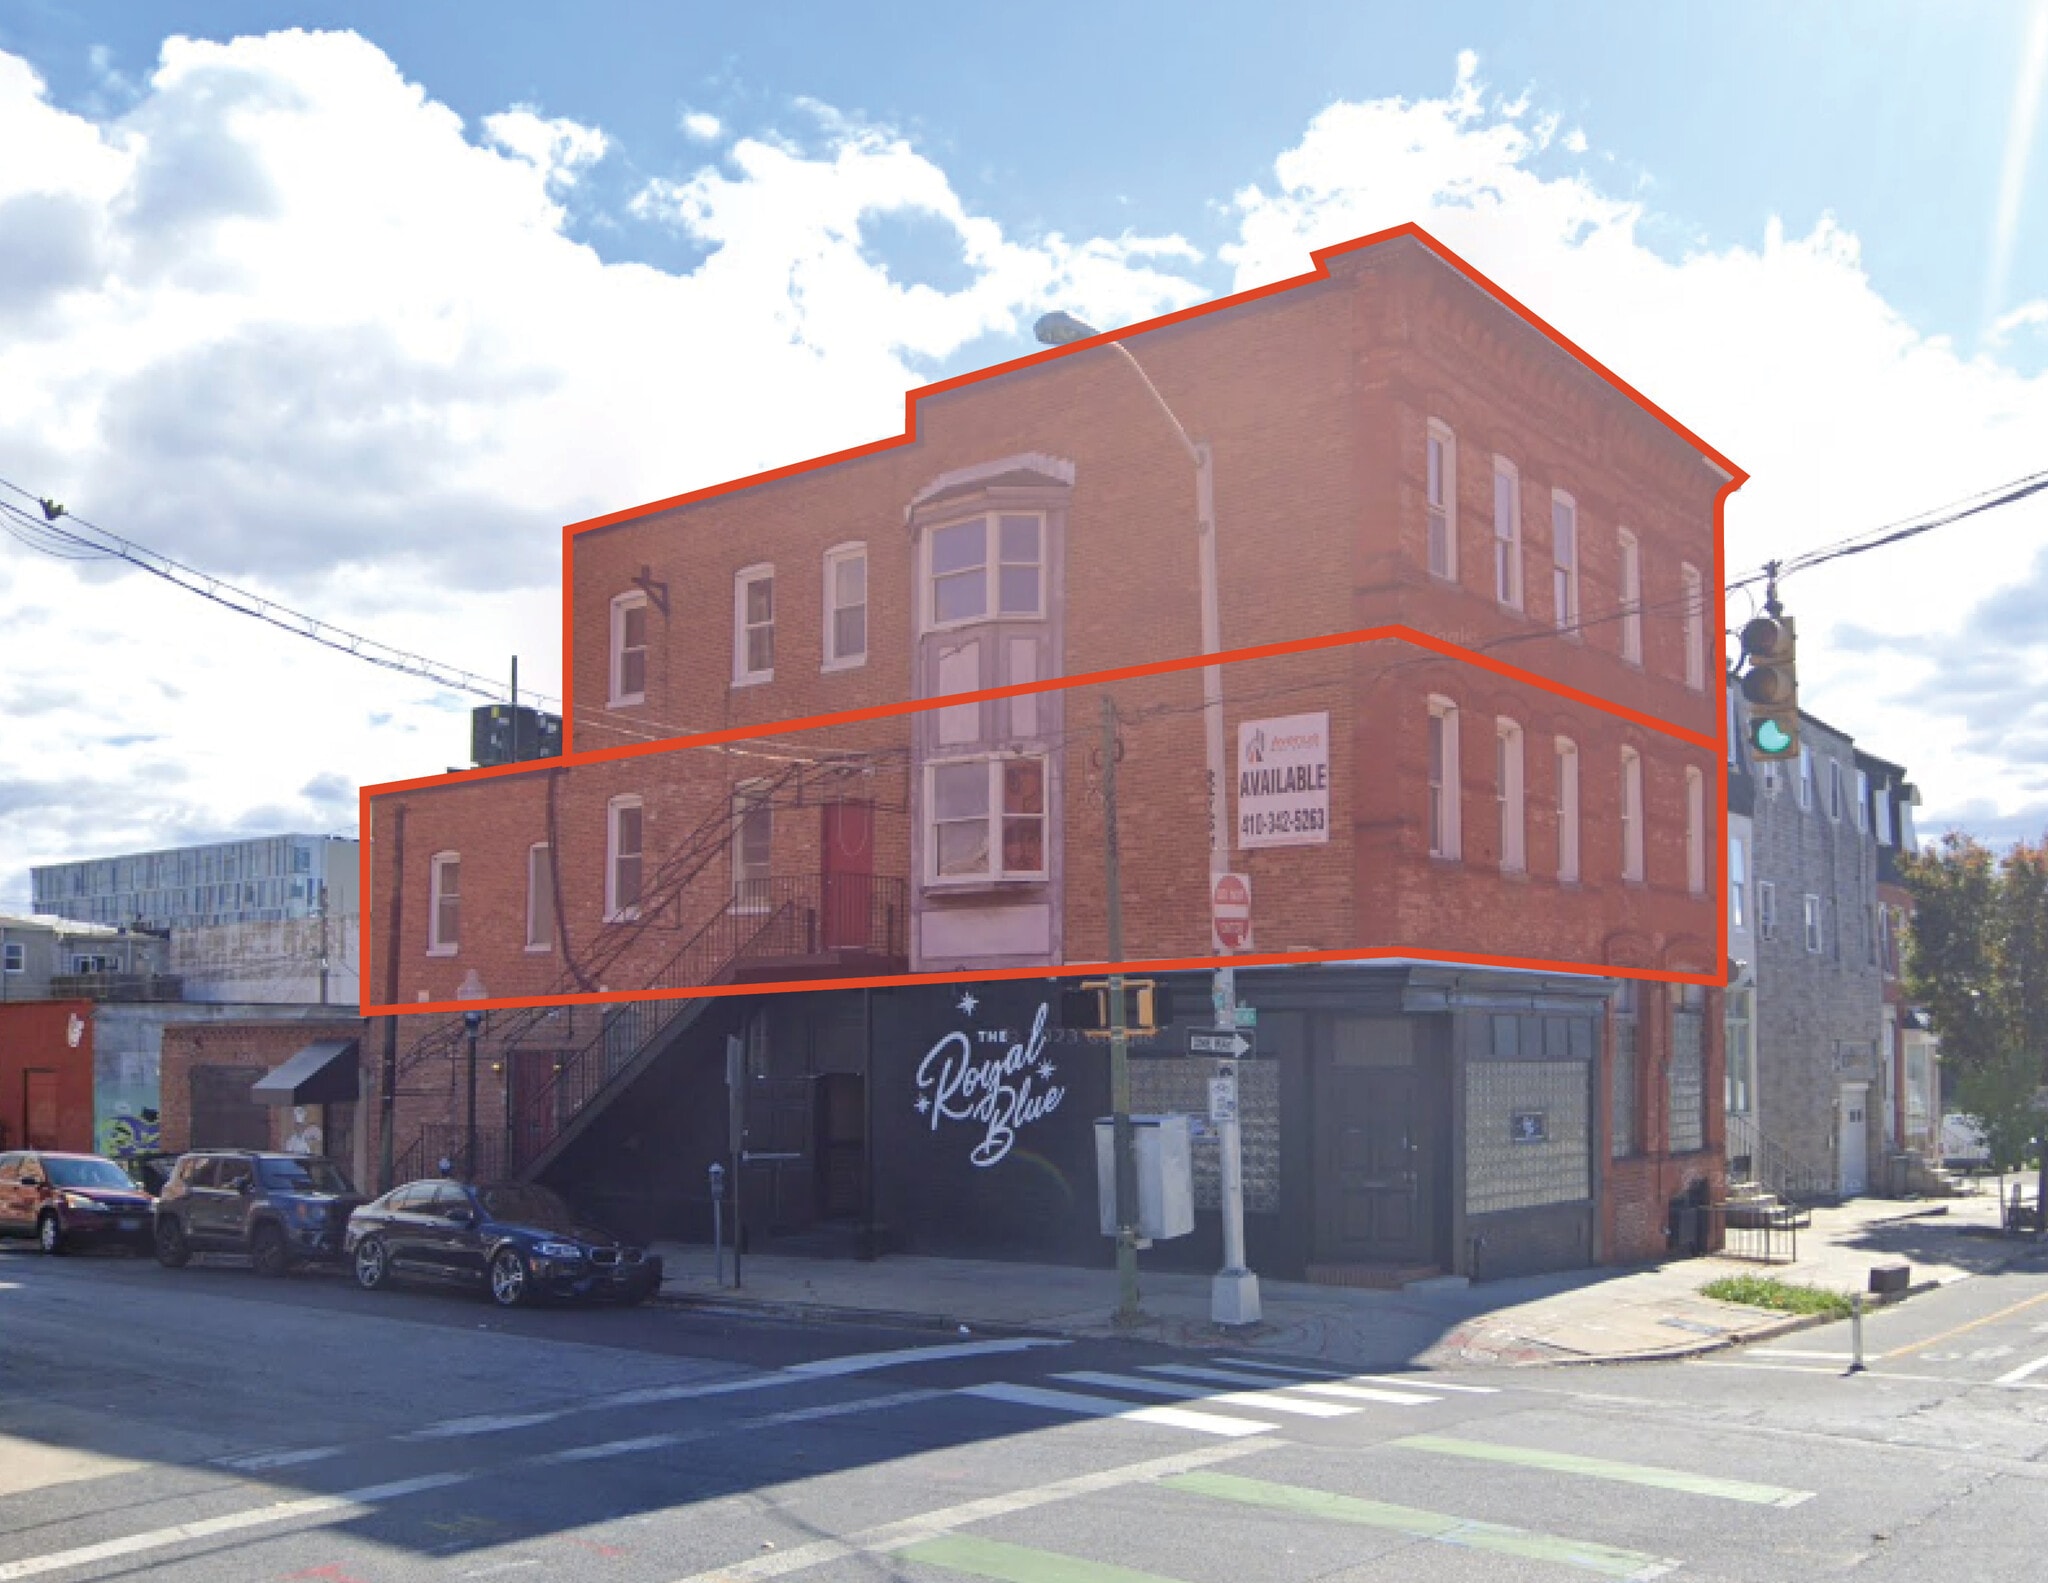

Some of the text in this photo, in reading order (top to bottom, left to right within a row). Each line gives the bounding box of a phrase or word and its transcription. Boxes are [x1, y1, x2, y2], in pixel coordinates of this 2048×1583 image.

[1240, 764, 1327, 797] AVAILABLE
[916, 1001, 1050, 1131] Royal
[978, 1031, 1008, 1043] THE
[970, 1075, 1066, 1167] Blue
